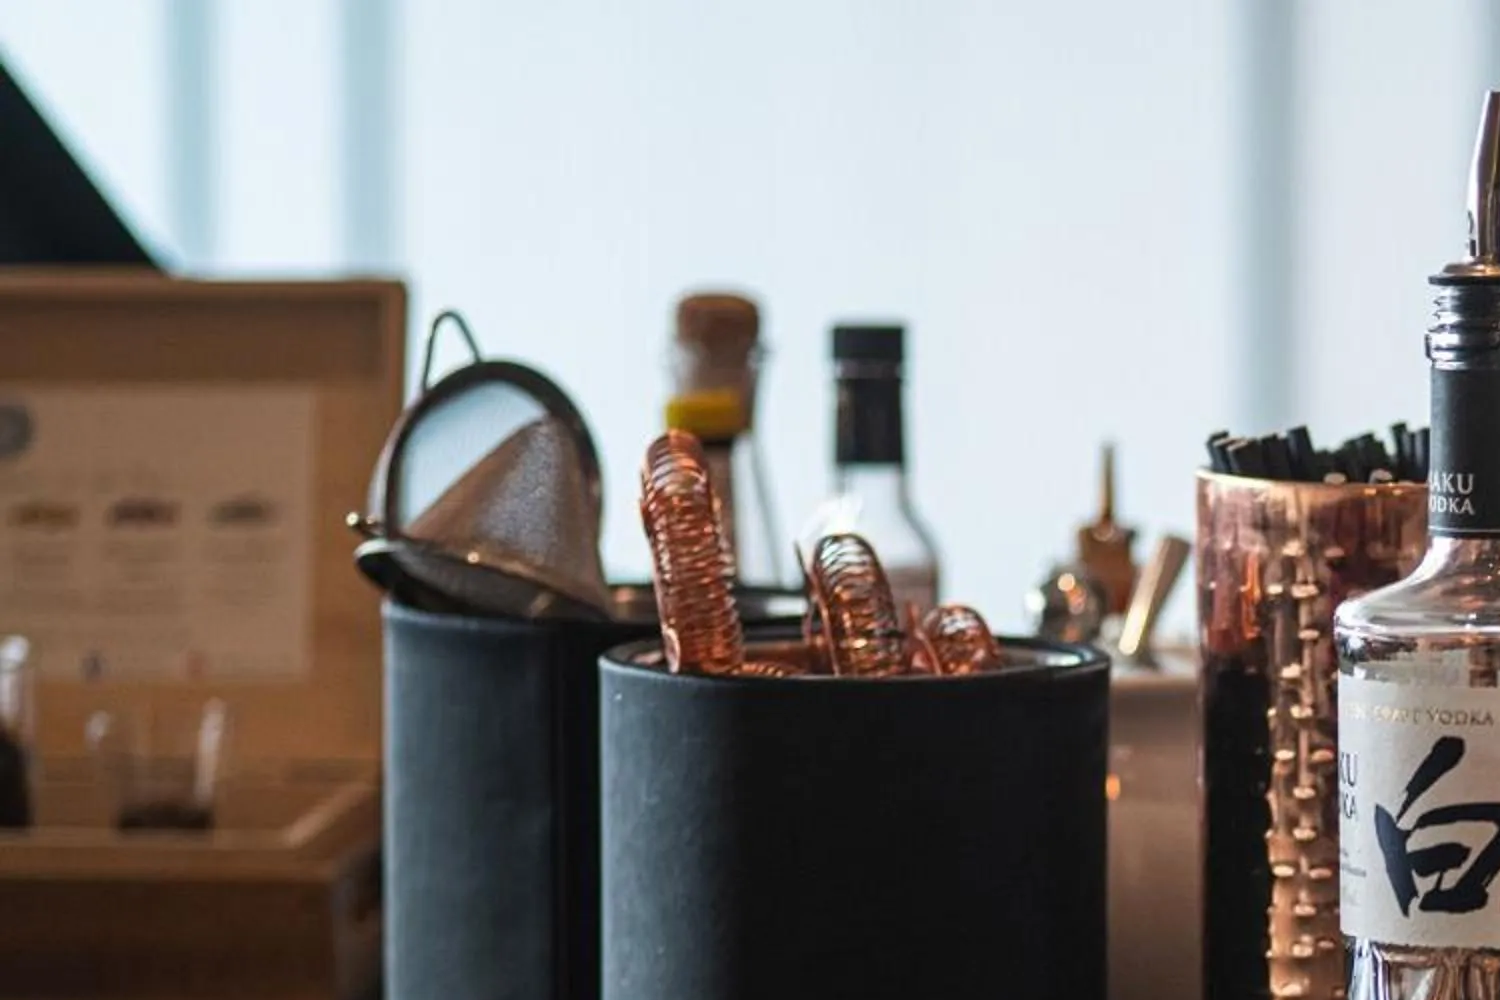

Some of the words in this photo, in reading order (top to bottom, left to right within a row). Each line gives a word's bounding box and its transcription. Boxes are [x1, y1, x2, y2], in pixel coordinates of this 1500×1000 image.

[1429, 471, 1475, 495] AKU
[1429, 495, 1476, 516] ODKA
[1426, 705, 1495, 727] VODKA
